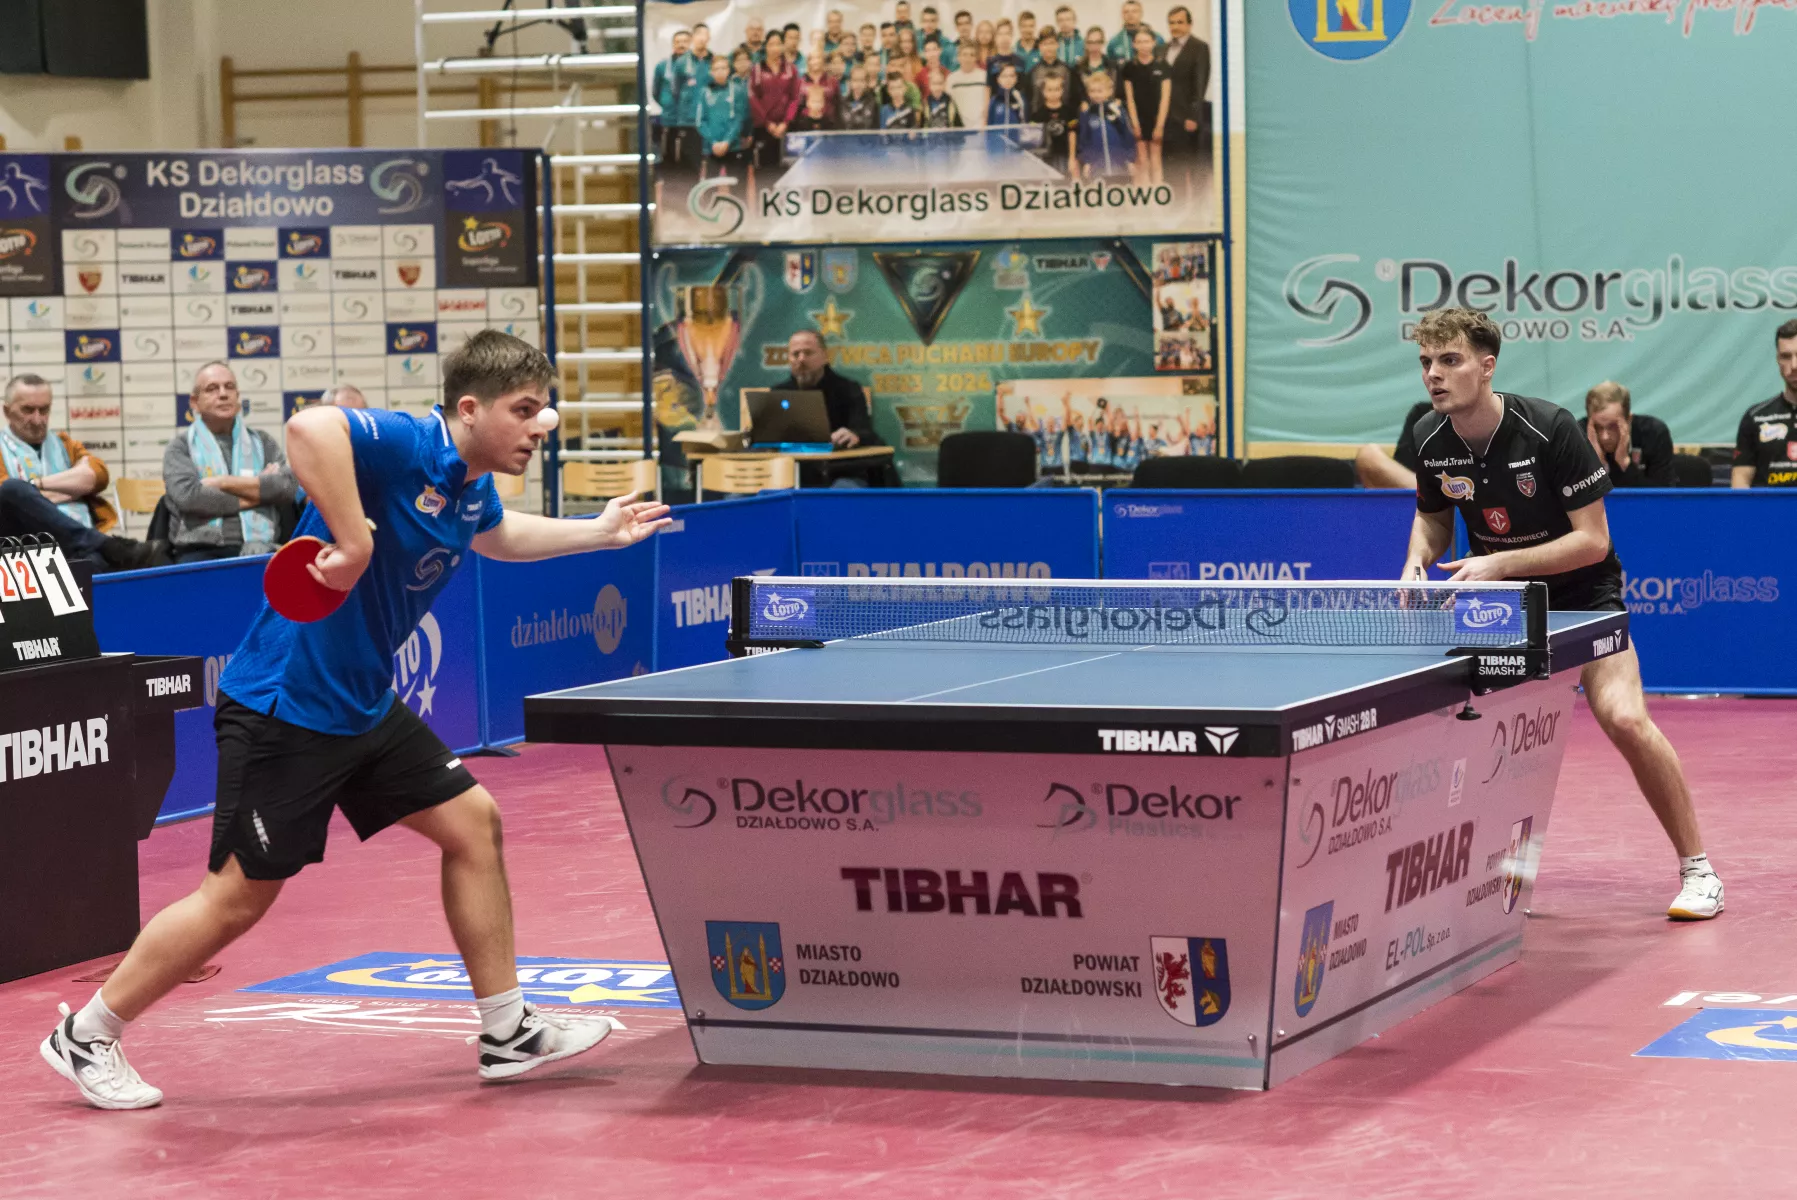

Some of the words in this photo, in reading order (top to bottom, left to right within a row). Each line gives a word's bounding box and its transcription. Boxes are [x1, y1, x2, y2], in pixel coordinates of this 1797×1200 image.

[147, 160, 190, 187] KS
[198, 159, 365, 191] Dekorglass
[180, 191, 334, 218] Działdowo
[762, 190, 802, 218] KS
[812, 184, 989, 220] Dekorglass
[1000, 181, 1173, 212] Działdowo
[1402, 254, 1797, 325] Dekorglass
[937, 372, 993, 393] 2024
[1572, 467, 1607, 493] PRYMUS
[17, 560, 37, 594] 2
[46, 557, 76, 608] 1
[1200, 562, 1312, 581] POWIAT
[671, 584, 732, 629] TIBHA
[773, 602, 800, 617] LOTTO
[1472, 607, 1503, 623] LOTTO
[13, 638, 62, 661] TIBHAR
[1593, 635, 1614, 658] TIBHAR
[1478, 655, 1526, 666] TIBHAR
[1479, 666, 1516, 676] SMASH
[146, 674, 191, 697] TIBHAR
[1292, 723, 1324, 752] TIBHAR
[1337, 714, 1359, 738] SMASH
[1511, 706, 1561, 756] Dekor
[1098, 729, 1197, 752] TIBHAR
[731, 777, 983, 824] Dekorglass
[1105, 784, 1242, 820] Dekor
[736, 816, 841, 831] DZIAŁDOWO
[846, 817, 880, 832] S.A.
[1384, 819, 1475, 915] TIBHAR
[840, 866, 1081, 918] TIBHAR
[1333, 914, 1359, 940] MIASTO
[796, 944, 862, 962] MIASTO
[1073, 954, 1140, 972] POWIAT
[799, 969, 900, 989] DZIAŁDOWO
[1021, 977, 1143, 999] DZIAŁDOWSKI
